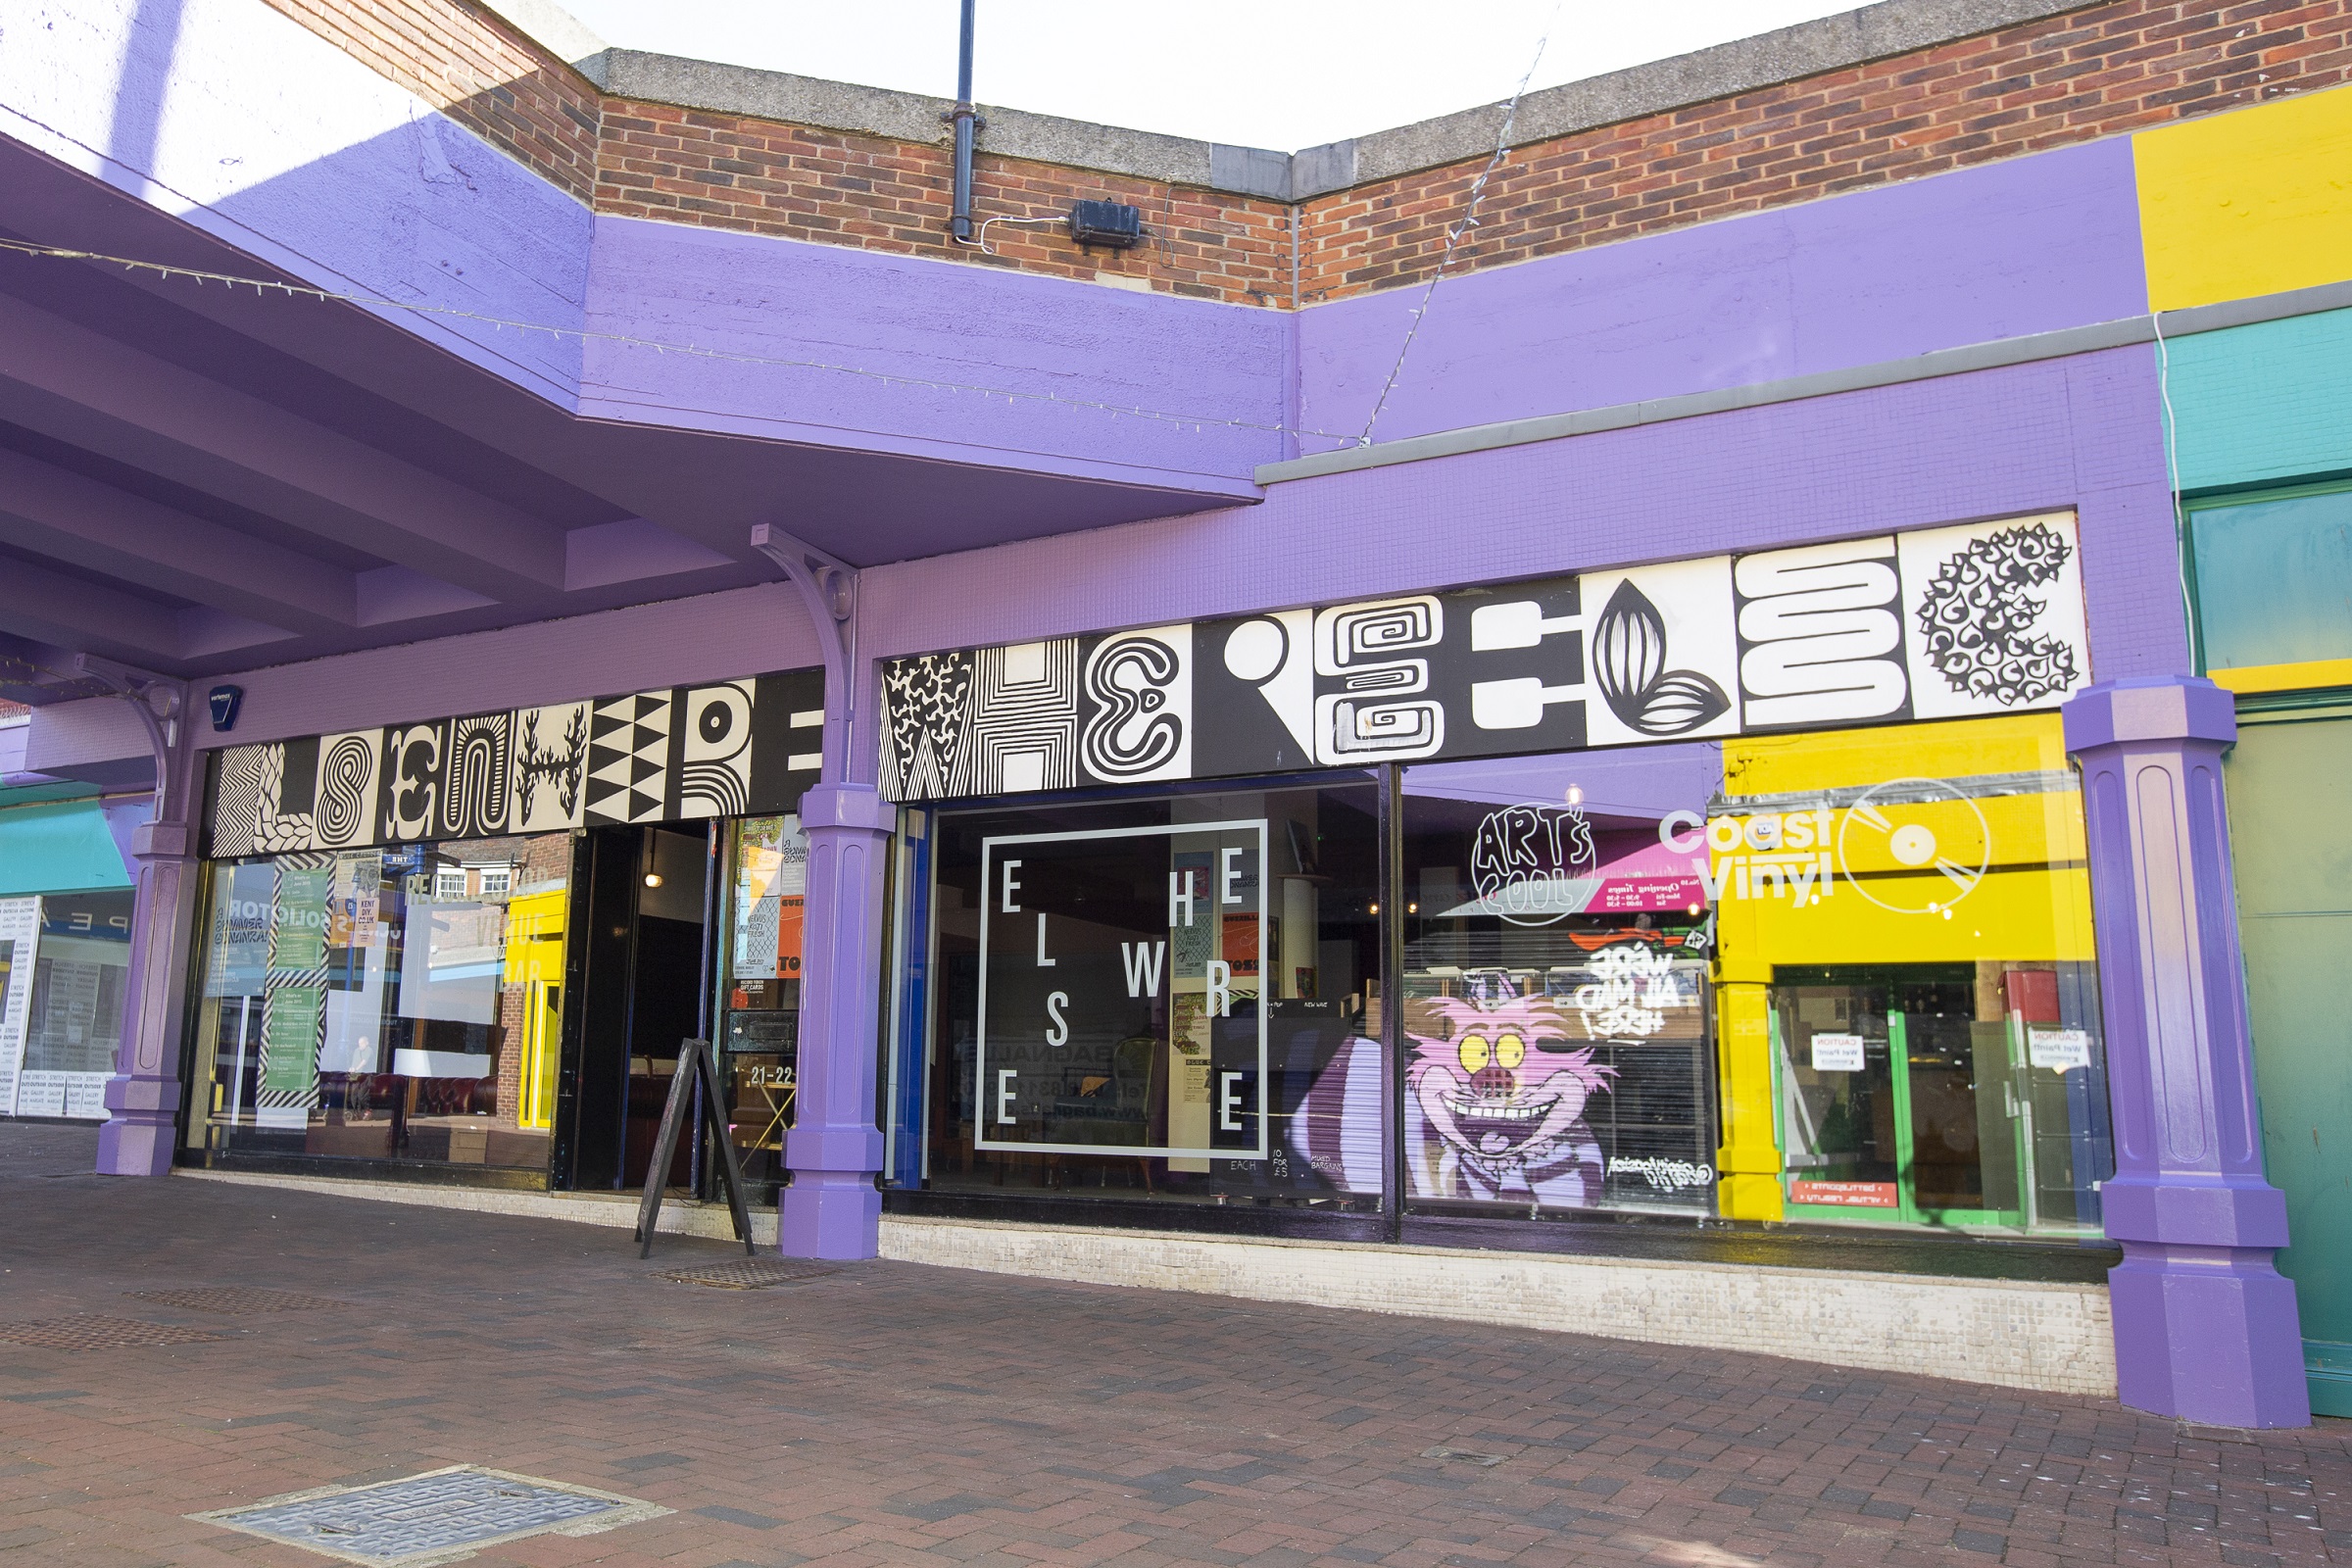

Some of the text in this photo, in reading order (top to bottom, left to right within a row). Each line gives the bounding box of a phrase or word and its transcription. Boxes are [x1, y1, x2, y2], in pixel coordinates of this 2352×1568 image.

[1658, 803, 1834, 854] Coast
[1480, 868, 1572, 914] COOL
[1691, 852, 1834, 907] Vinyl
[752, 1066, 793, 1085] 21-22
[1230, 1159, 1256, 1170] EACH
